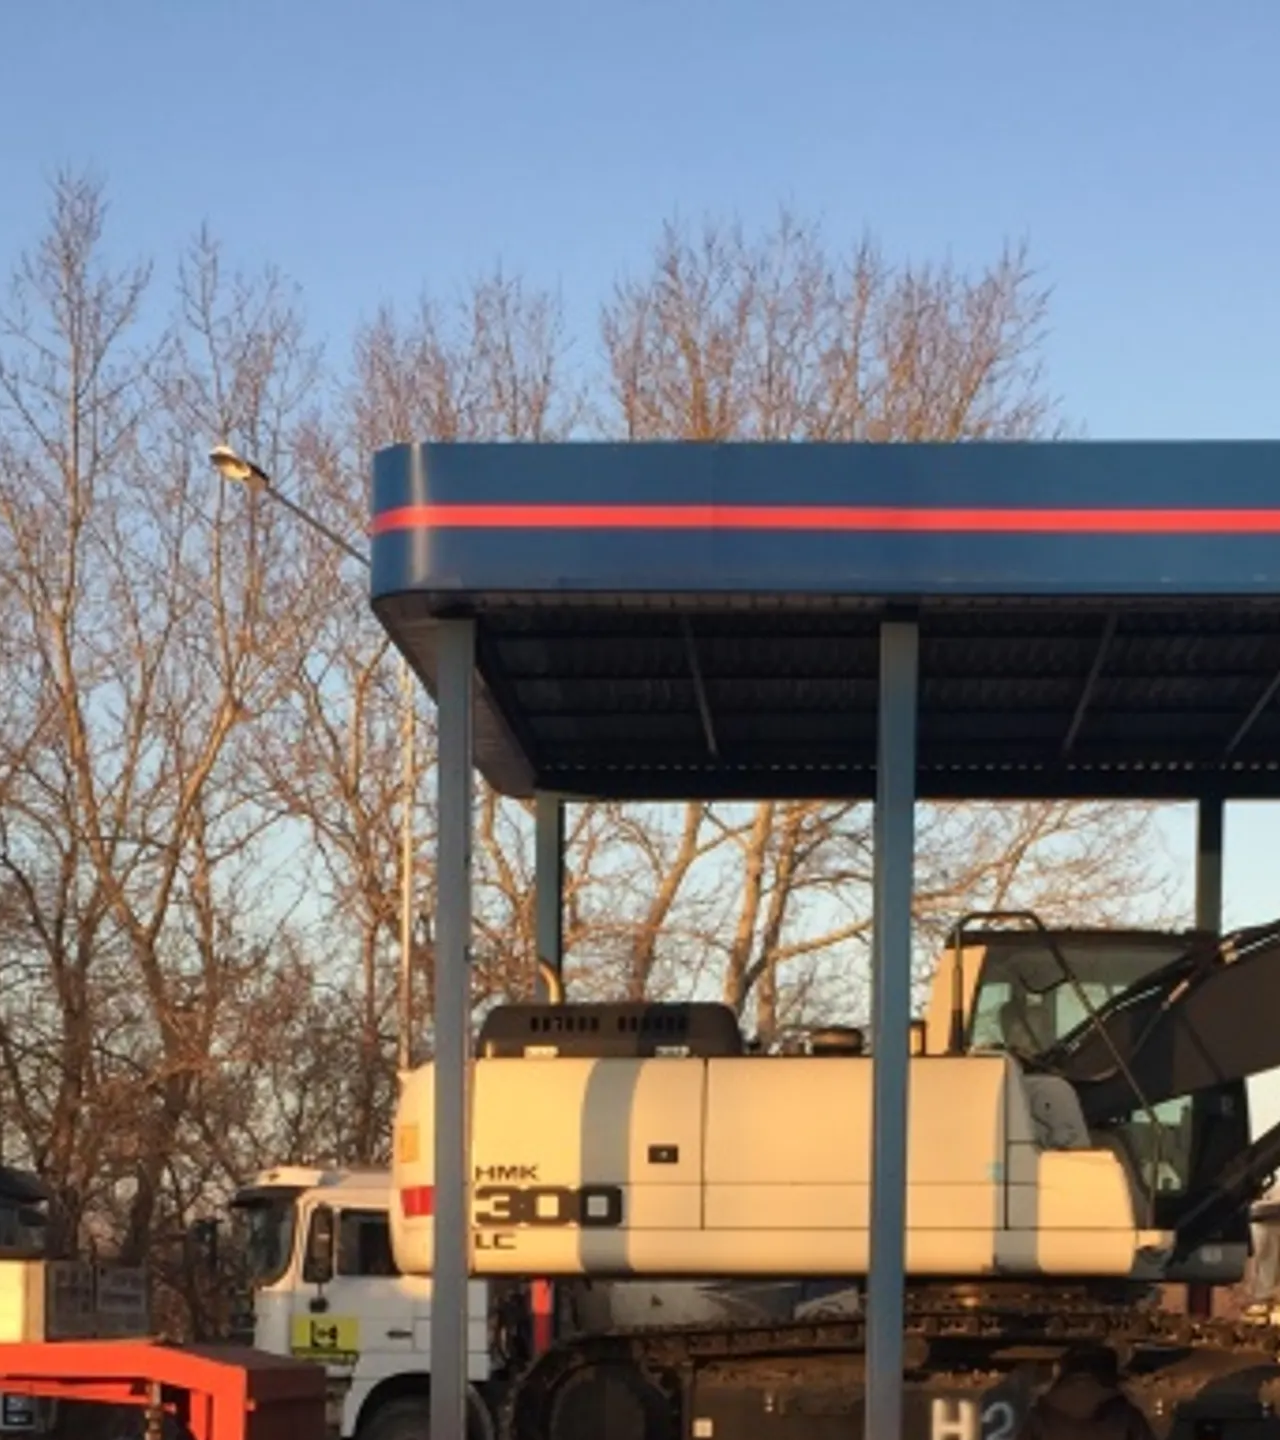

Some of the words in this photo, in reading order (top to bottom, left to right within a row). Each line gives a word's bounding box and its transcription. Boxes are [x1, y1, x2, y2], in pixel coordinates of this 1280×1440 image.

[474, 1164, 539, 1181] HMK
[474, 1185, 623, 1226] 300
[474, 1233, 516, 1250] LC
